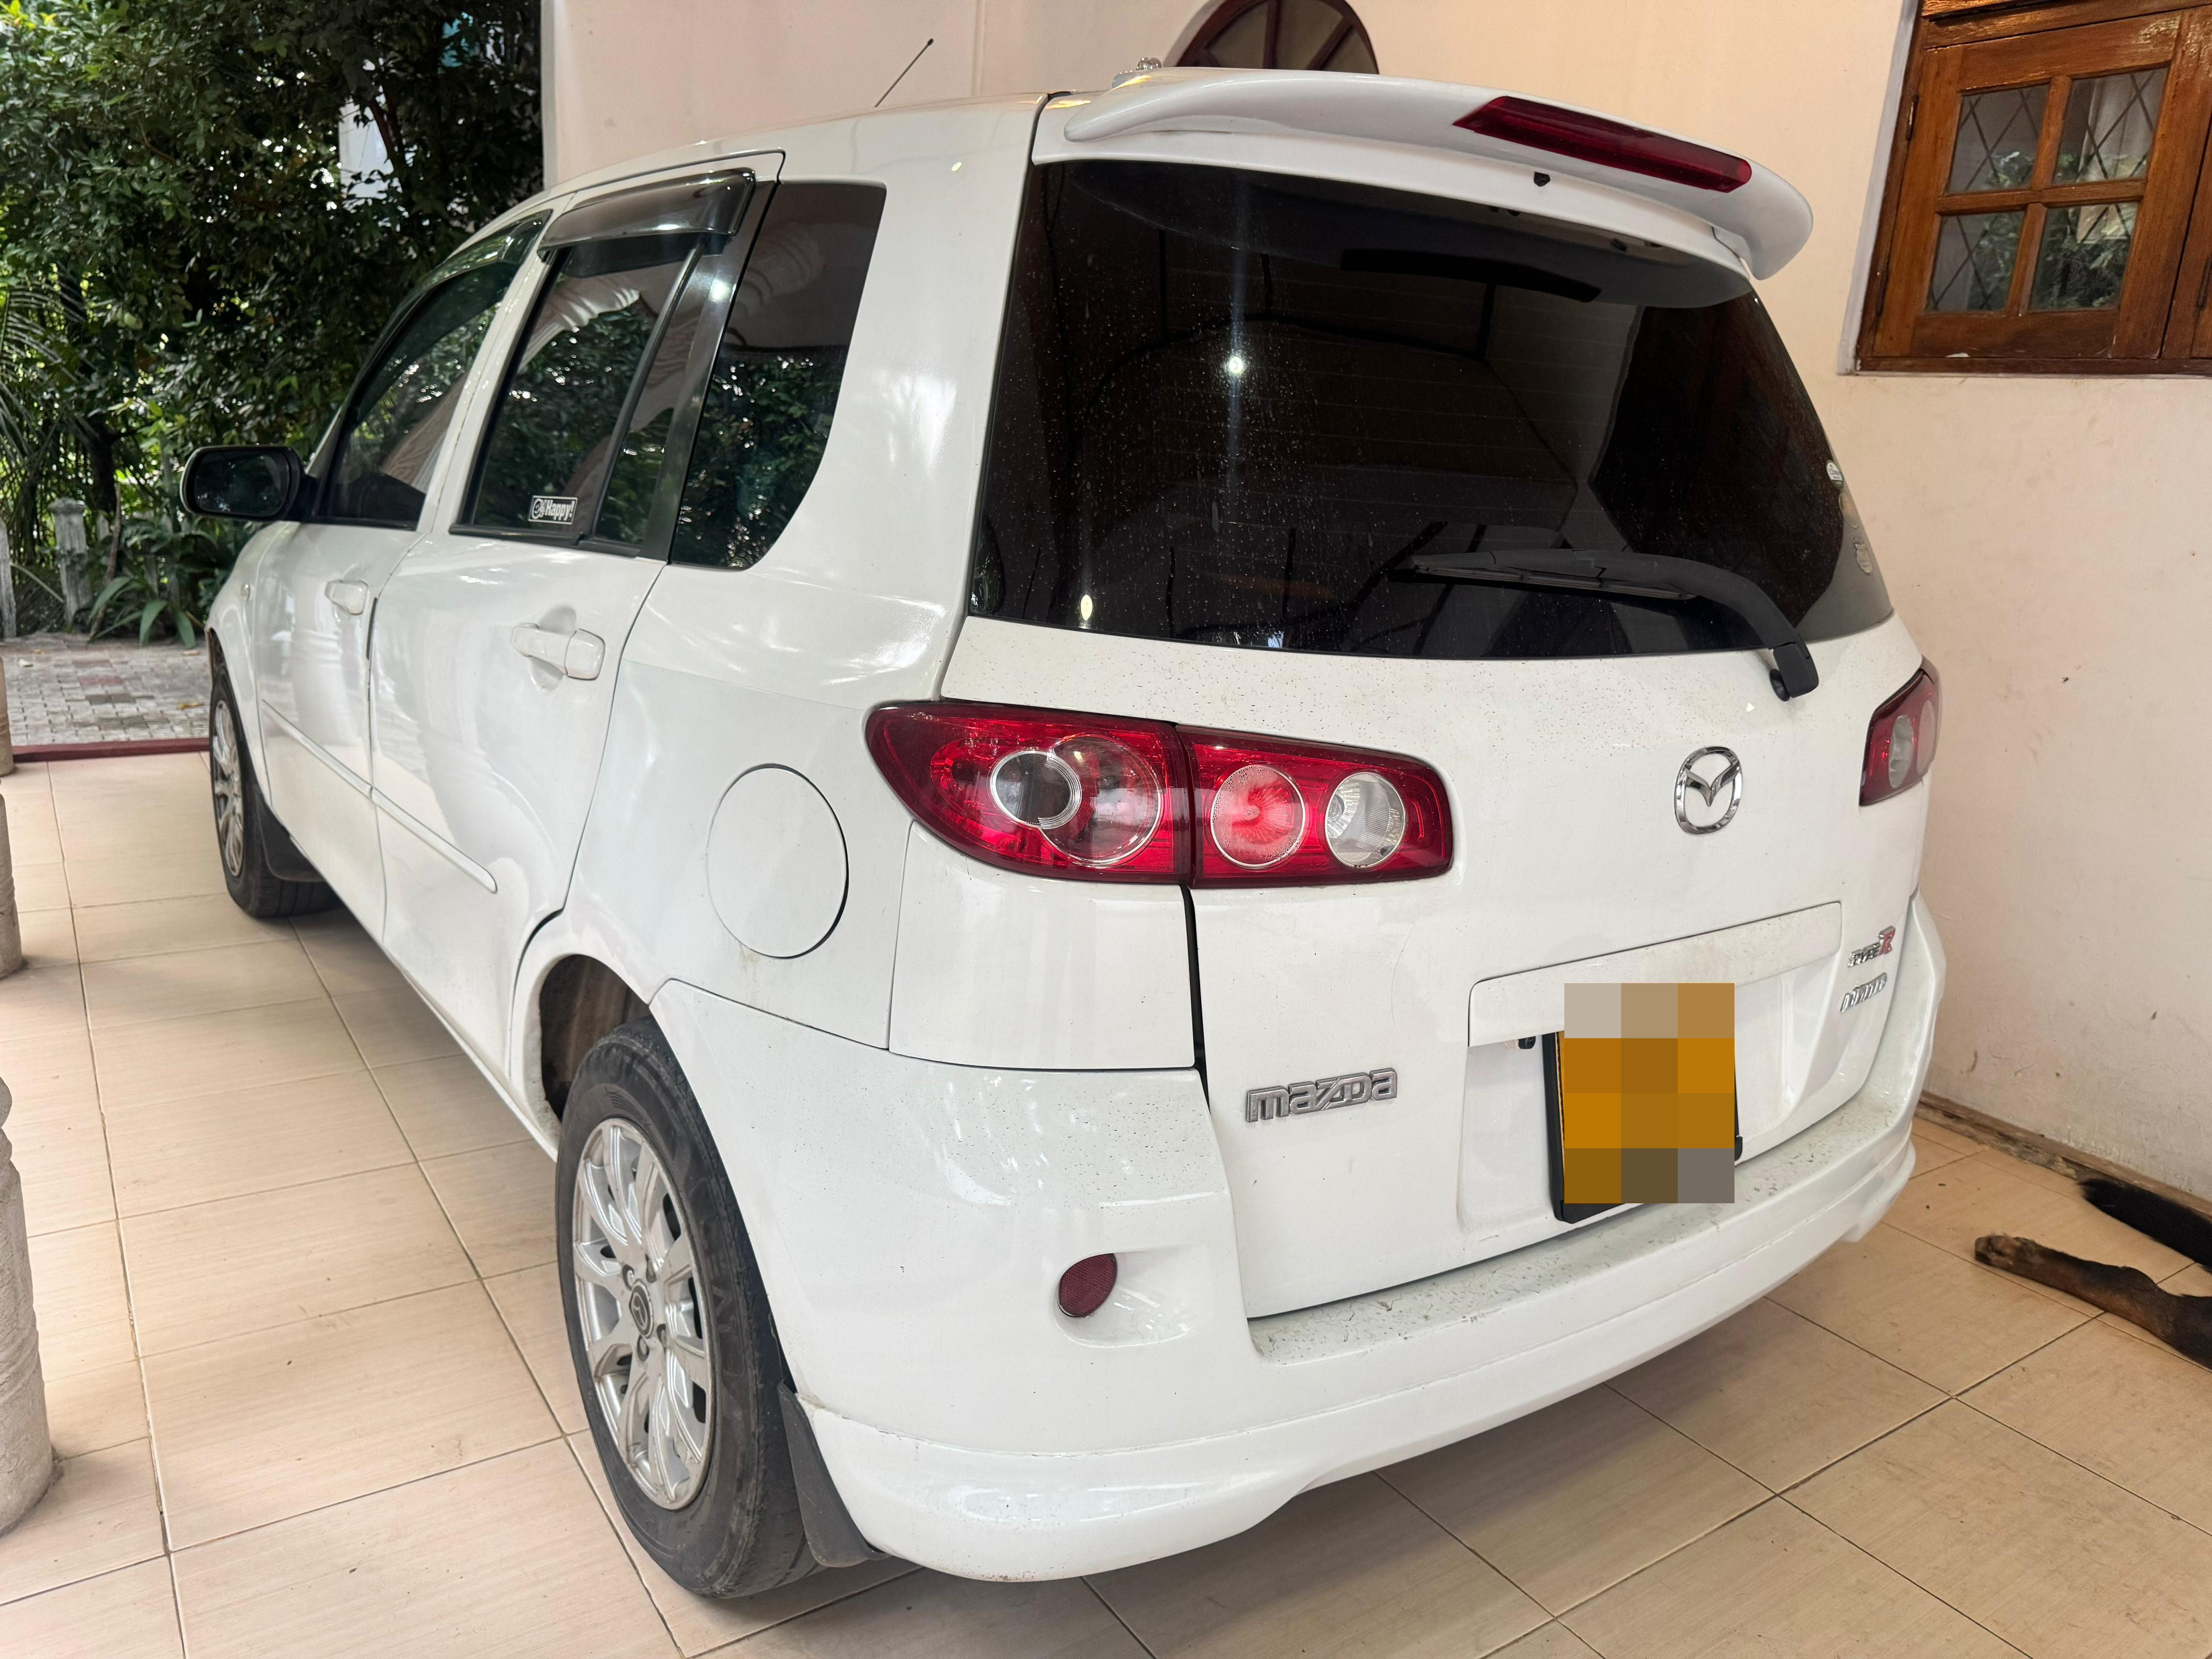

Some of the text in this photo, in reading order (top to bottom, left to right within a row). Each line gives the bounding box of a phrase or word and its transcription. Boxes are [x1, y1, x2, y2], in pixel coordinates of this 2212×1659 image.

[544, 499, 575, 521] Happy!
[1878, 925, 1896, 956] R
[1246, 1068, 1398, 1123] mazda
